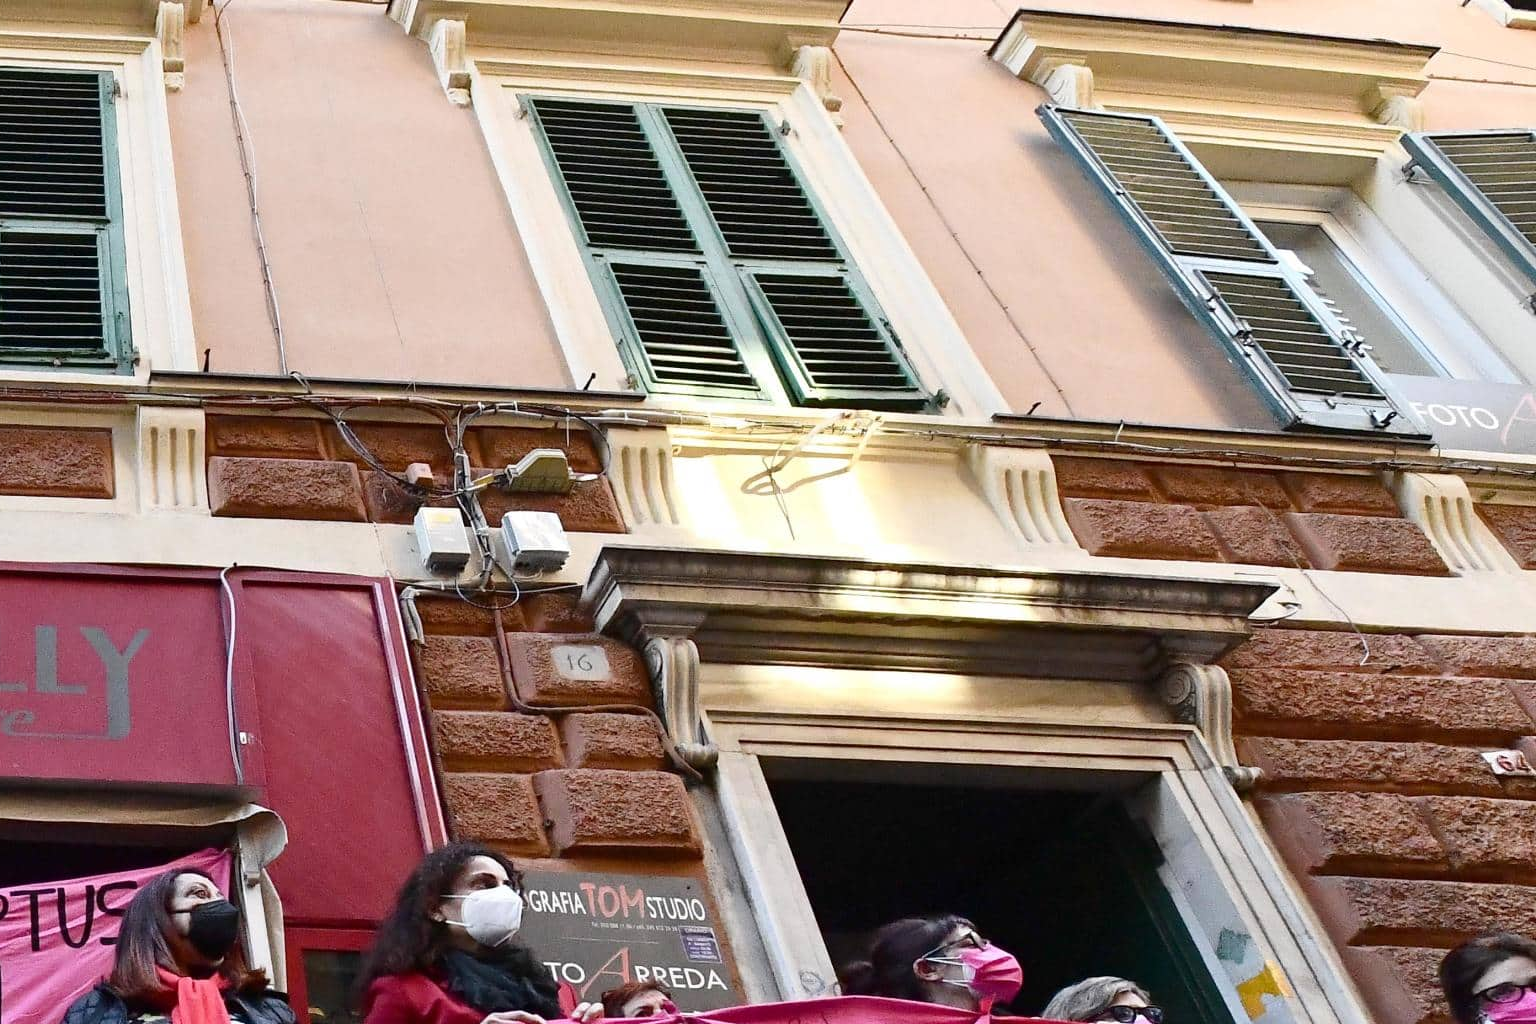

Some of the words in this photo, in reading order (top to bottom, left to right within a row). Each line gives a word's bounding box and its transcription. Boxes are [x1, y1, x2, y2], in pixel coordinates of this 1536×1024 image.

[567, 653, 592, 671] 16
[529, 889, 586, 917] GRAFIA
[579, 881, 645, 918] TOM
[645, 896, 706, 921] STUDIO
[543, 961, 586, 983] TO
[580, 947, 728, 999] ARREDA
